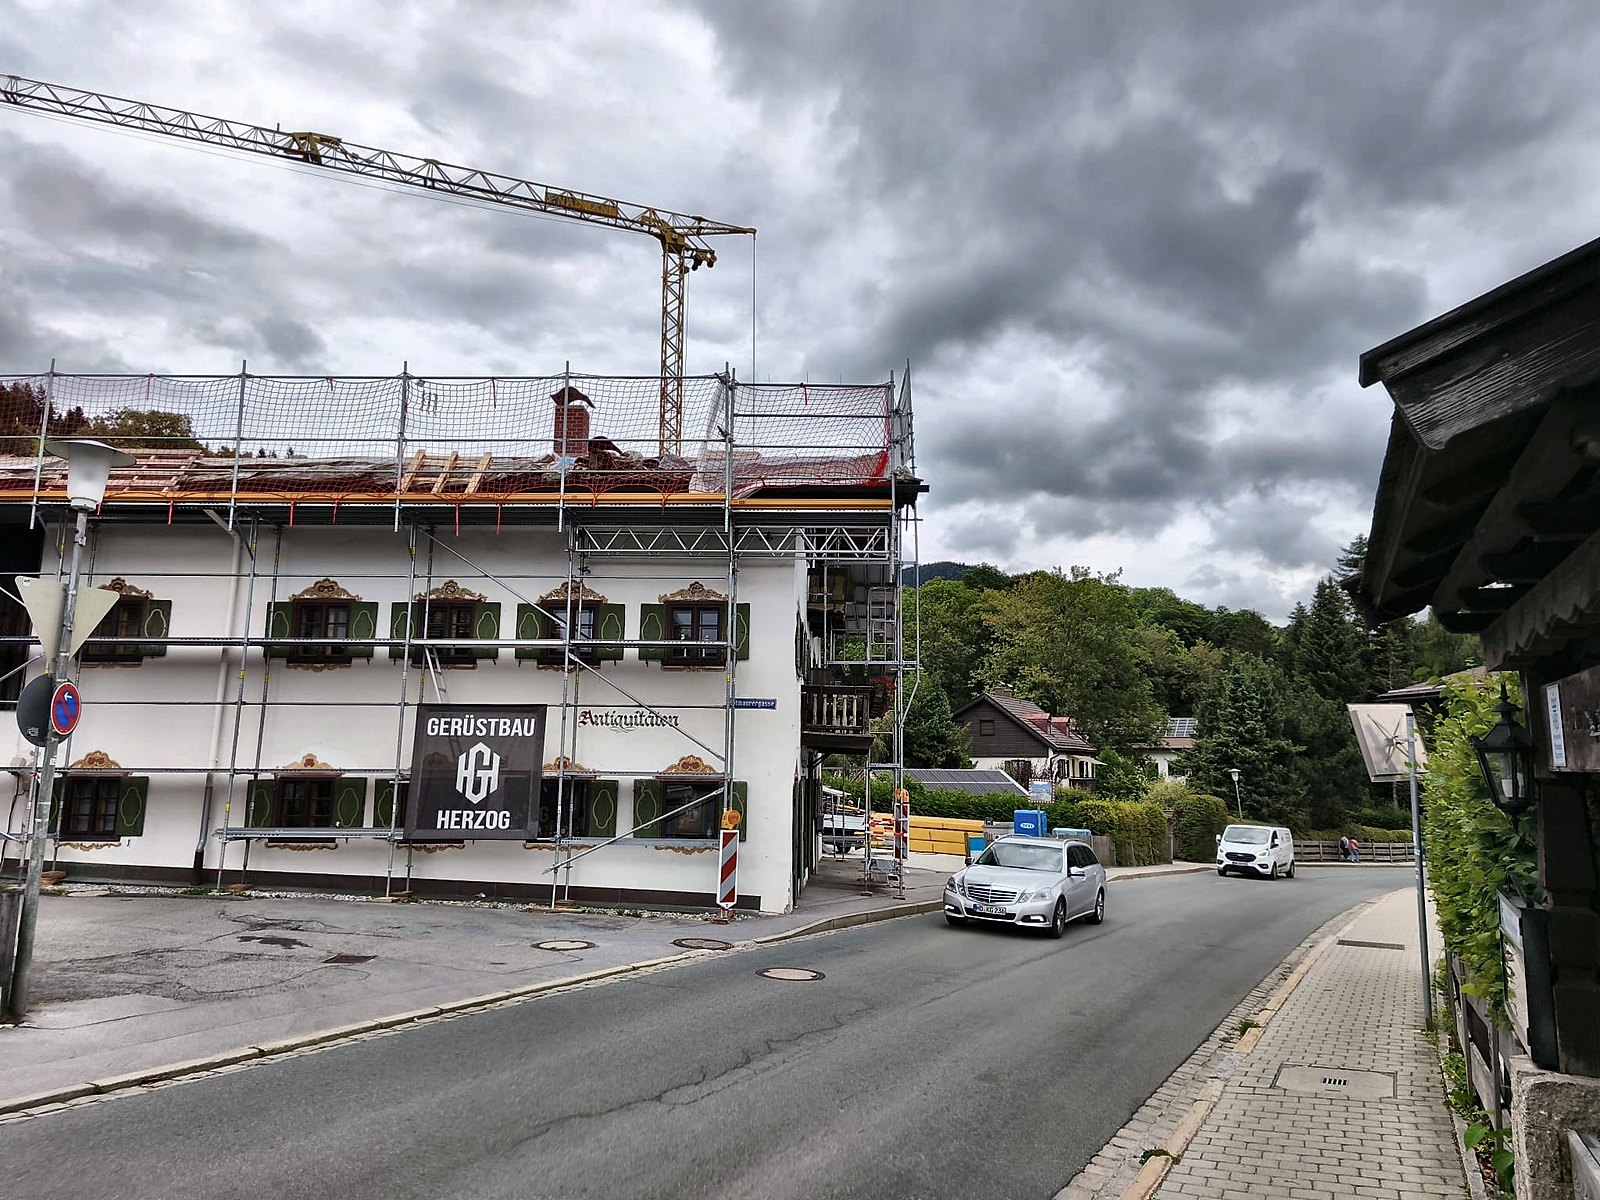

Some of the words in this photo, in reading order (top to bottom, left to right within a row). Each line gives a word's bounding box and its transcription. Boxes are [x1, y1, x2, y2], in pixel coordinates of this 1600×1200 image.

[427, 715, 535, 736] GERÜSTBAU
[578, 710, 679, 732] Antiquitäten
[437, 810, 510, 829] HERZOG
